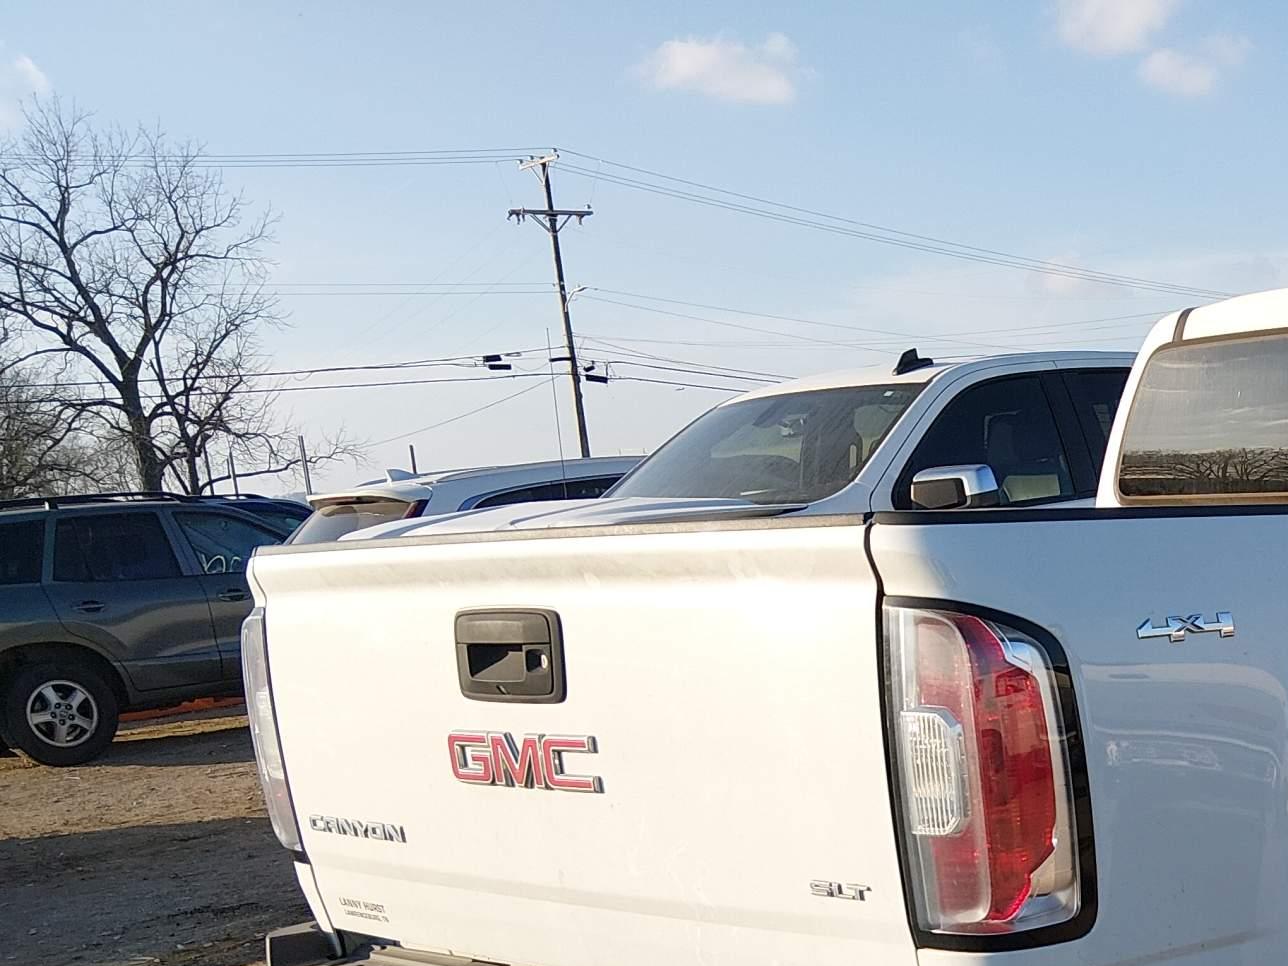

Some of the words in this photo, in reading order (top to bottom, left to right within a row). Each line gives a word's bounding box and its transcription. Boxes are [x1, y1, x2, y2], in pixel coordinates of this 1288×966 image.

[447, 729, 604, 793] GMC
[309, 814, 407, 843] CANYON
[809, 879, 872, 901] SLT
